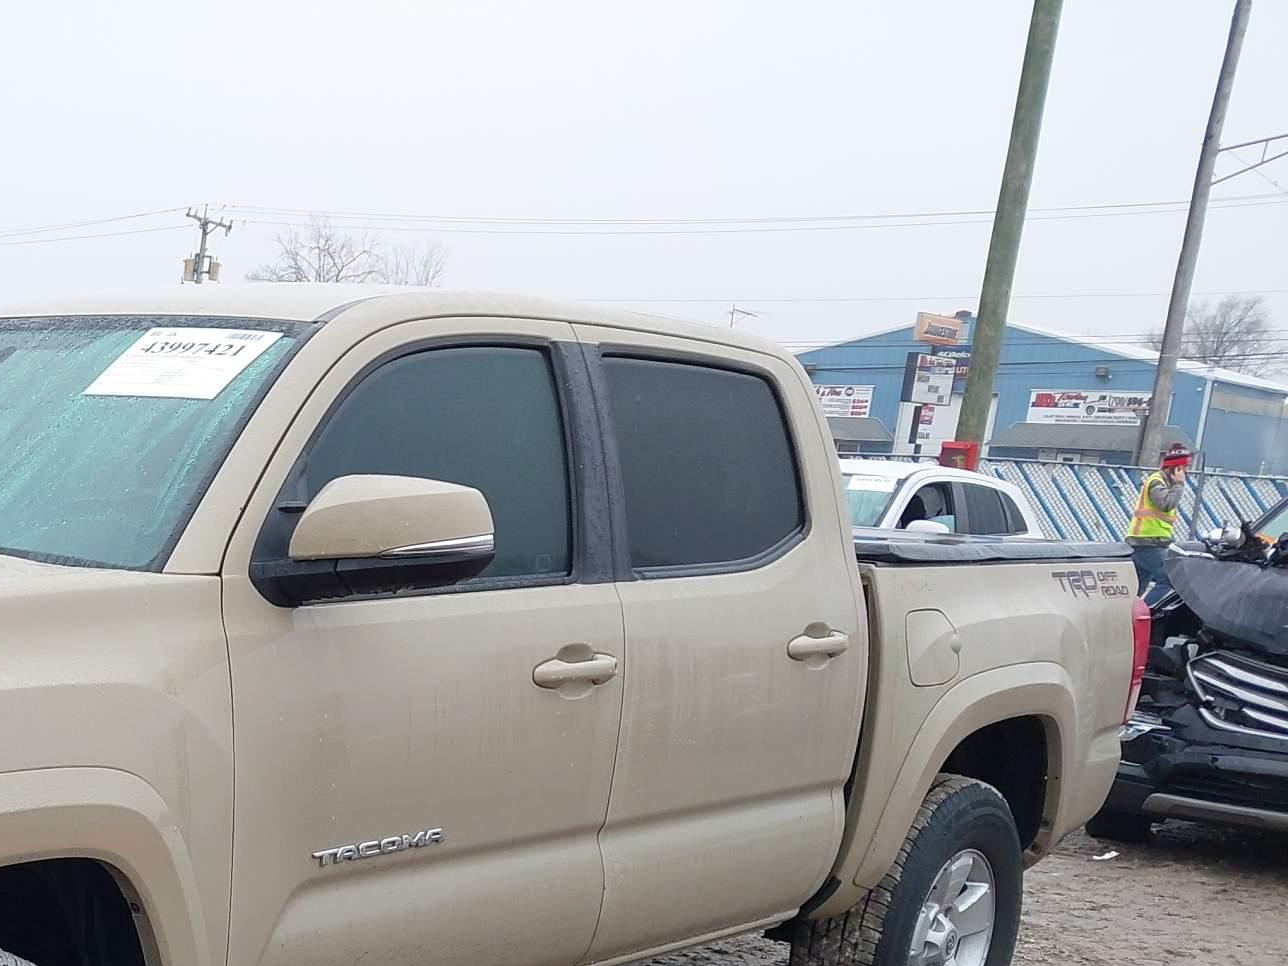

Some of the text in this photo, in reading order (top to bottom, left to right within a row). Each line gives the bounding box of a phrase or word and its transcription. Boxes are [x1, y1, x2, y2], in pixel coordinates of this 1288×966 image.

[140, 341, 246, 356] 43997421
[1052, 570, 1118, 598] TRD OFF
[1101, 585, 1129, 597] ROAD
[312, 827, 444, 866] TACOMA
